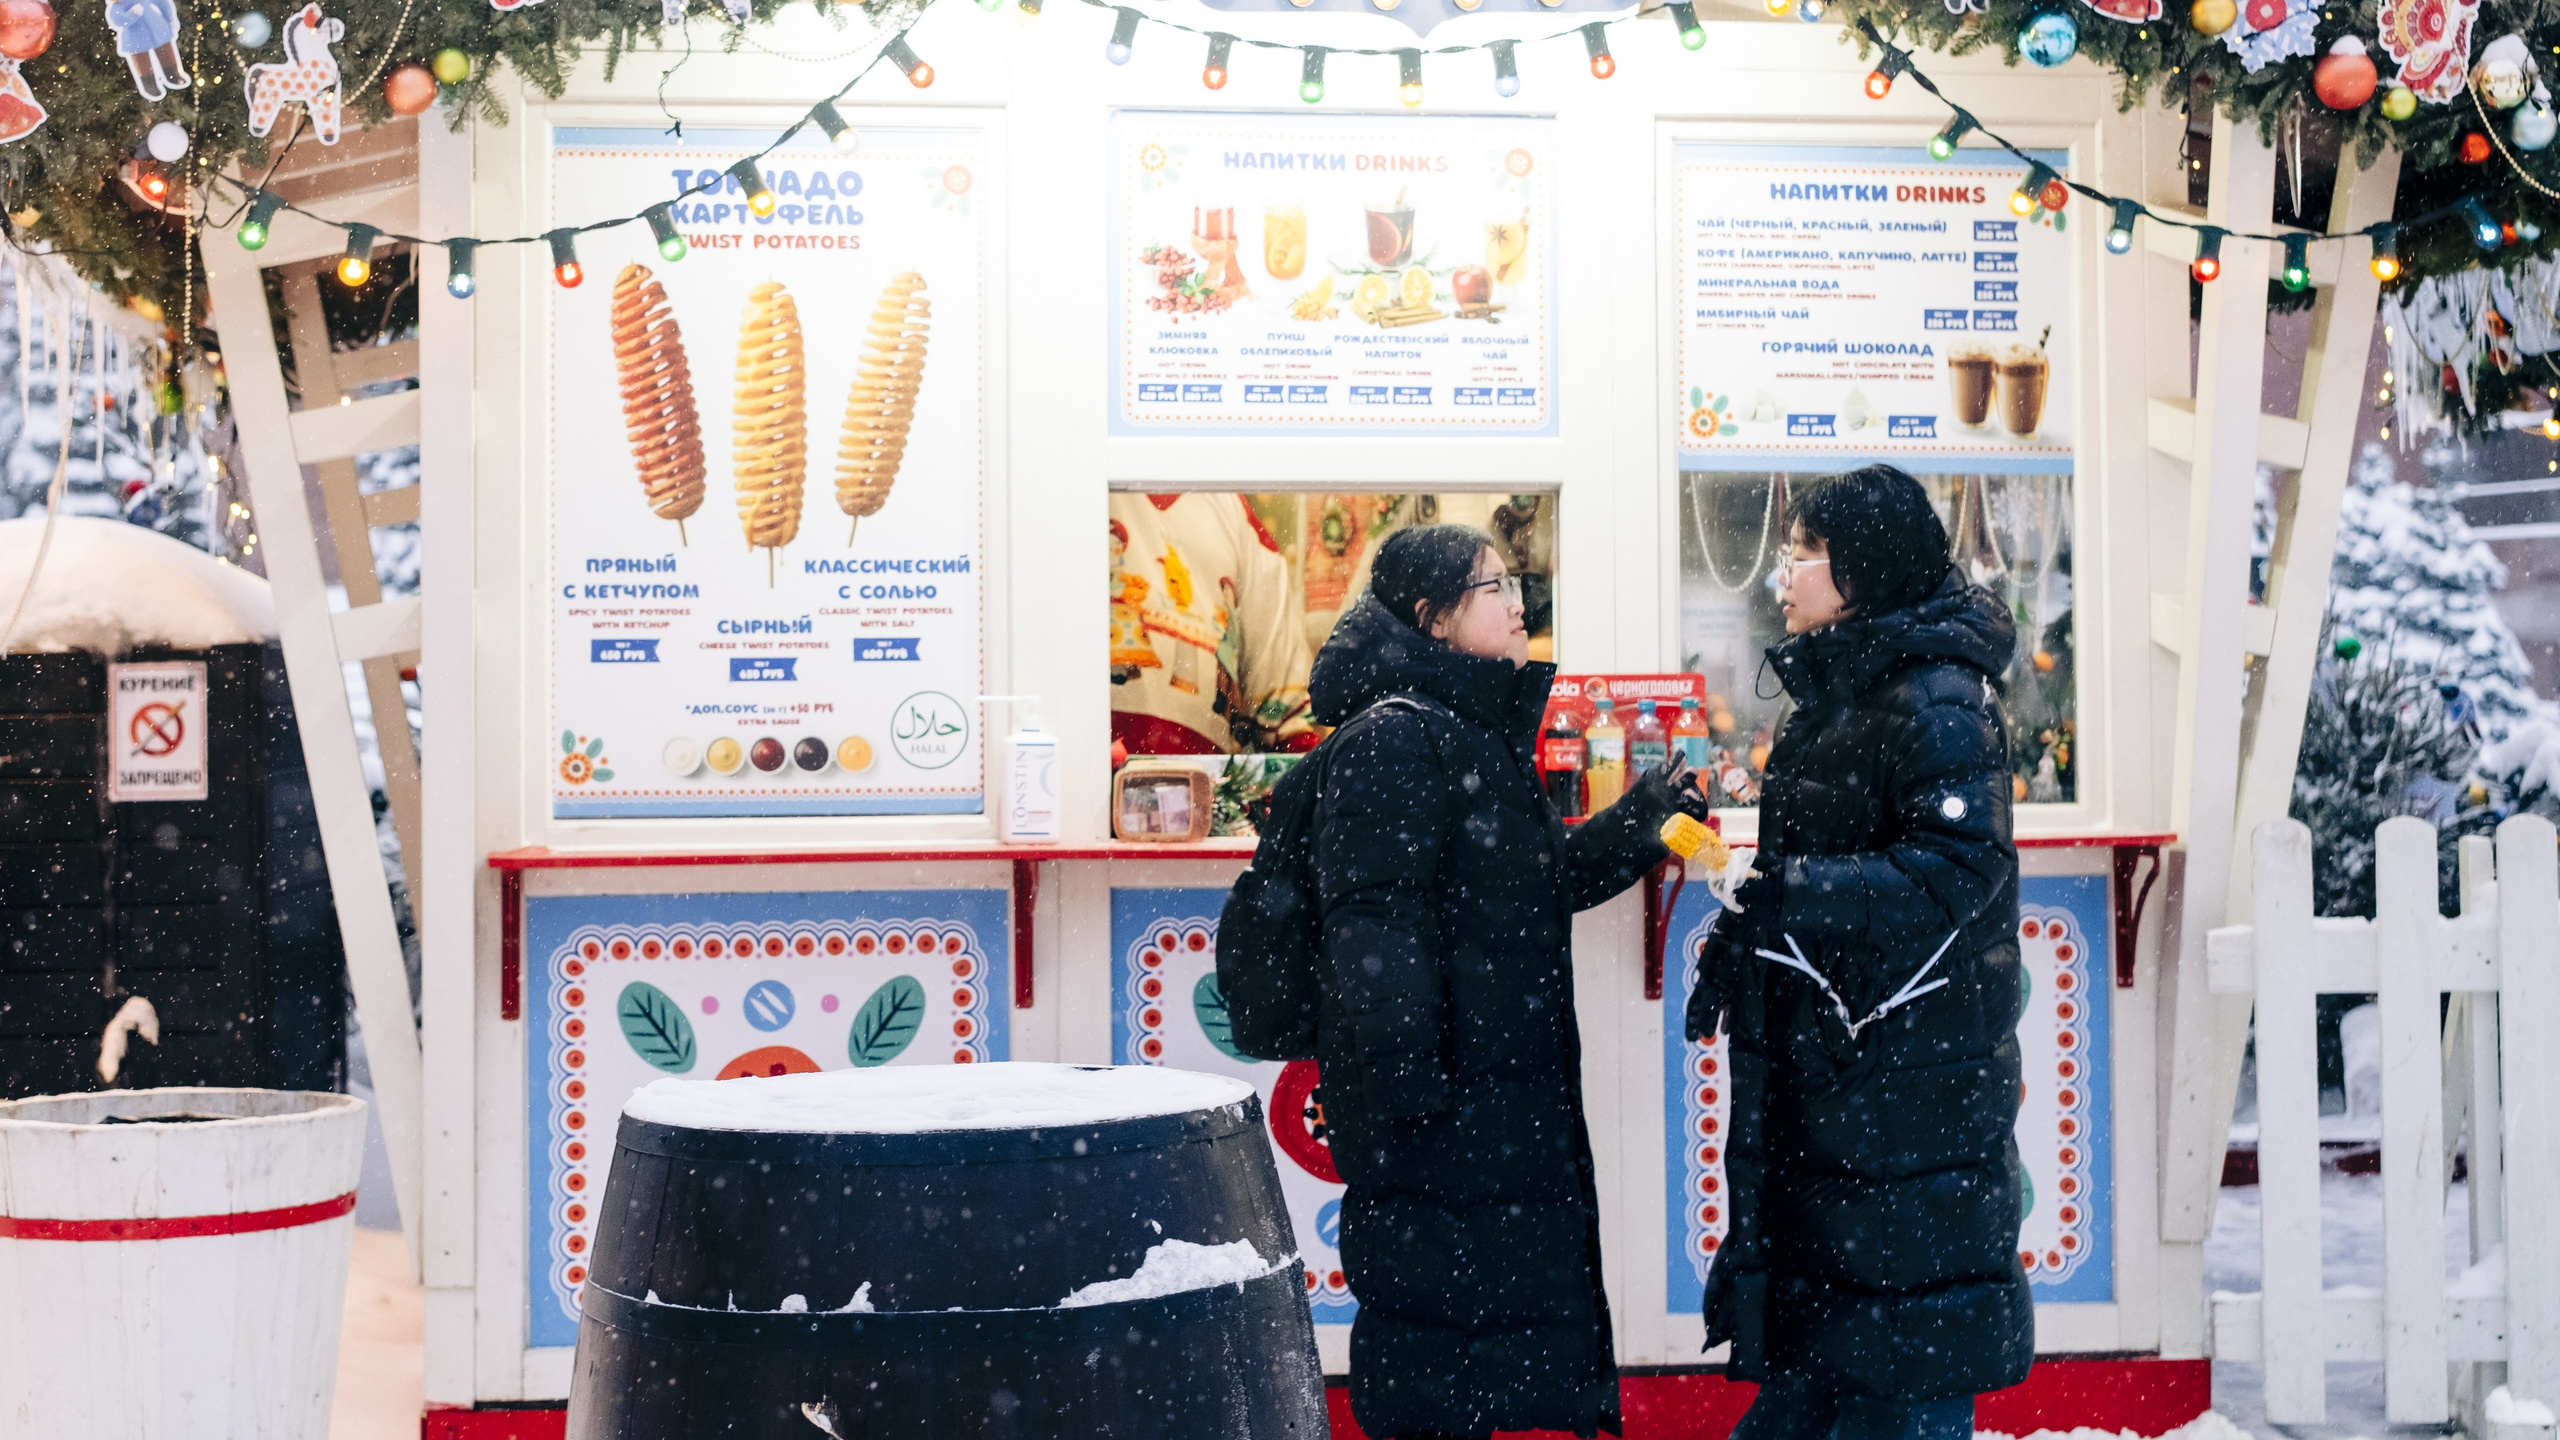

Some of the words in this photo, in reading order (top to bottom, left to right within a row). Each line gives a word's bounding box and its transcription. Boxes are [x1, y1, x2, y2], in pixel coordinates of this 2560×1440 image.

[1224, 152, 1345, 170] НАПИТКИ
[1355, 154, 1448, 172] DRINKS
[1770, 183, 1888, 201] НАПИТКИ
[1896, 185, 1986, 203] DRINKS
[1697, 216, 1725, 228] ЧАЙ
[1731, 217, 1797, 231] (ЧЕРНЫЙ,
[1802, 218, 1872, 232] КРАСНЫЙ,
[1878, 220, 1947, 233] ЗЕЛЕНЫЙ)
[753, 234, 860, 249] POTATOES
[1697, 248, 1736, 258] КОФЕ
[1741, 248, 1834, 261] (АМЕРИКАНО,
[1838, 252, 1917, 262] КАПУЧИНО,
[1921, 252, 1967, 263] ЛАТТЕ)
[1697, 278, 1797, 289] МИНЕРАЛЬНАЯ
[1802, 280, 1840, 290] ВОДА
[1697, 308, 1776, 319] ИМБИРНЫЙ
[1781, 308, 1810, 319] ЧАЙ
[1158, 331, 1207, 339] ЗИМНЯЯ
[1267, 333, 1305, 341] ПУНШ
[1334, 334, 1449, 344] РОЖДЕСТВЕНСКИЙ
[1461, 335, 1529, 345] ЯБЛОЧНЫЙ
[1150, 347, 1218, 355] КЛЮКОВКА
[1240, 346, 1332, 356] ОБЛЕПИХОВЫЙ
[1483, 349, 1507, 359] ЧАЙ
[1762, 338, 1838, 353] ГОРЯЧИЙ
[1845, 343, 1934, 357] ШОКОЛАД
[1365, 351, 1422, 359] НАПИТОК
[587, 554, 676, 573] ПРЯНЫЙ
[805, 555, 970, 573] КЛАССИЧЕСКИЙ
[563, 585, 576, 598] С
[585, 585, 699, 598] КЕТЧУПОМ
[838, 585, 850, 599] С
[860, 585, 937, 599] СОЛЬЮ
[717, 615, 812, 633] СЫРНЫЙ
[120, 676, 195, 691] КУРЕНИЕ
[814, 704, 834, 714] РУБ
[896, 705, 962, 739] حلال
[911, 744, 947, 754] HALAL
[121, 770, 201, 786] ЗАПРЕЩЕНО
